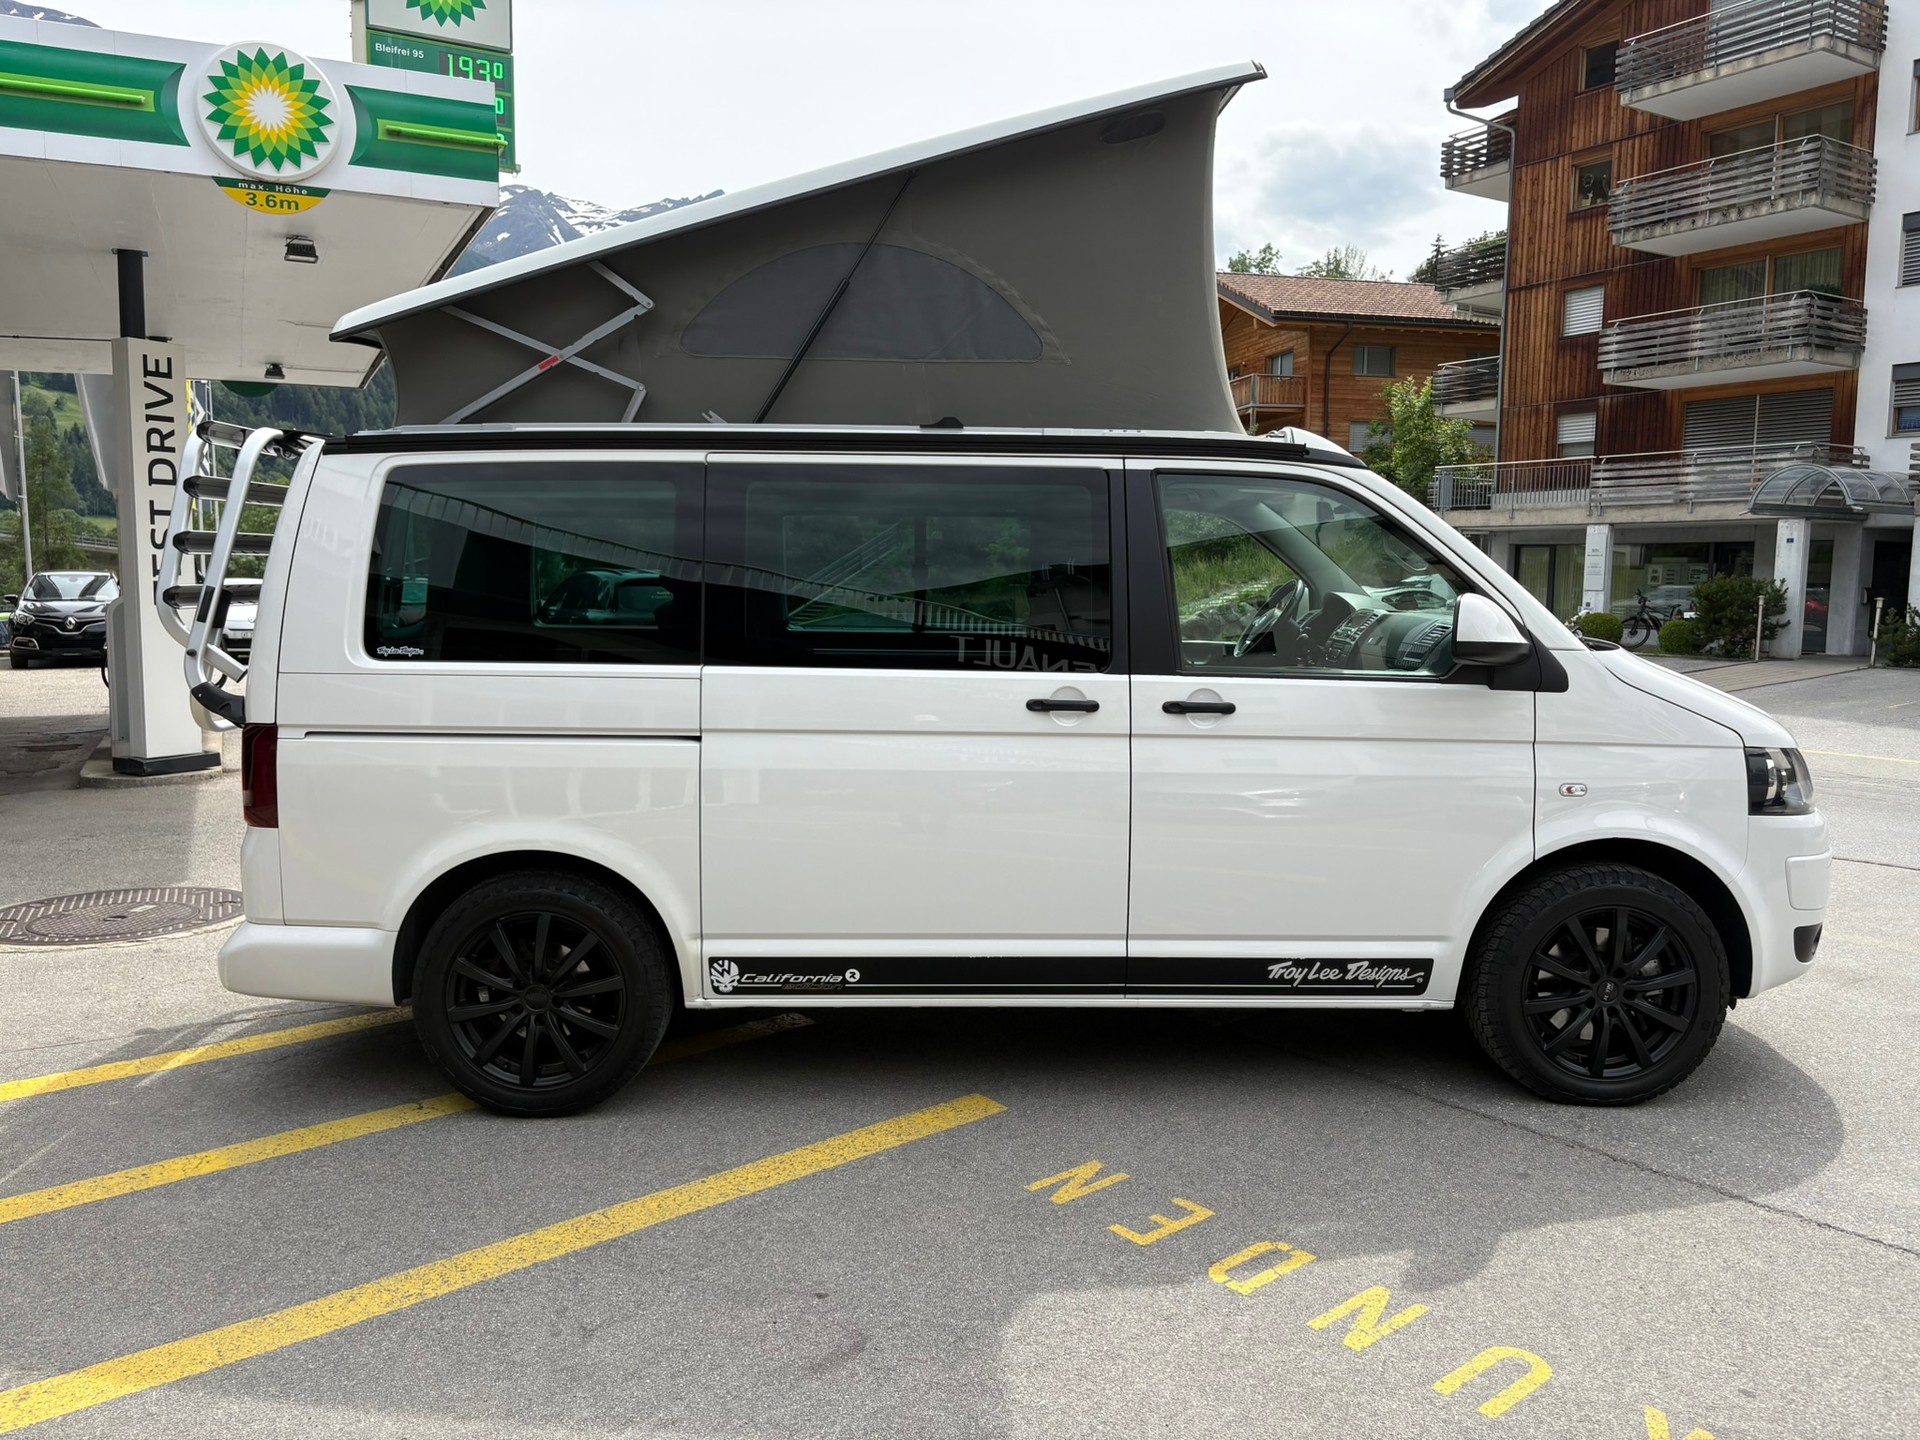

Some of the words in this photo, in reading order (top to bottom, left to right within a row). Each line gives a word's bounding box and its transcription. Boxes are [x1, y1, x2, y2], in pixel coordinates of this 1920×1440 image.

[375, 42, 410, 57] Bleifrei
[412, 49, 425, 59] 95
[238, 181, 269, 191] max.
[275, 184, 308, 195] Höhe
[245, 192, 300, 211] 3.6m
[142, 353, 178, 487] DRIVE
[740, 973, 844, 983] California
[1267, 961, 1308, 987] Troy
[1307, 961, 1343, 980] Lee
[1345, 960, 1425, 988] Designs
